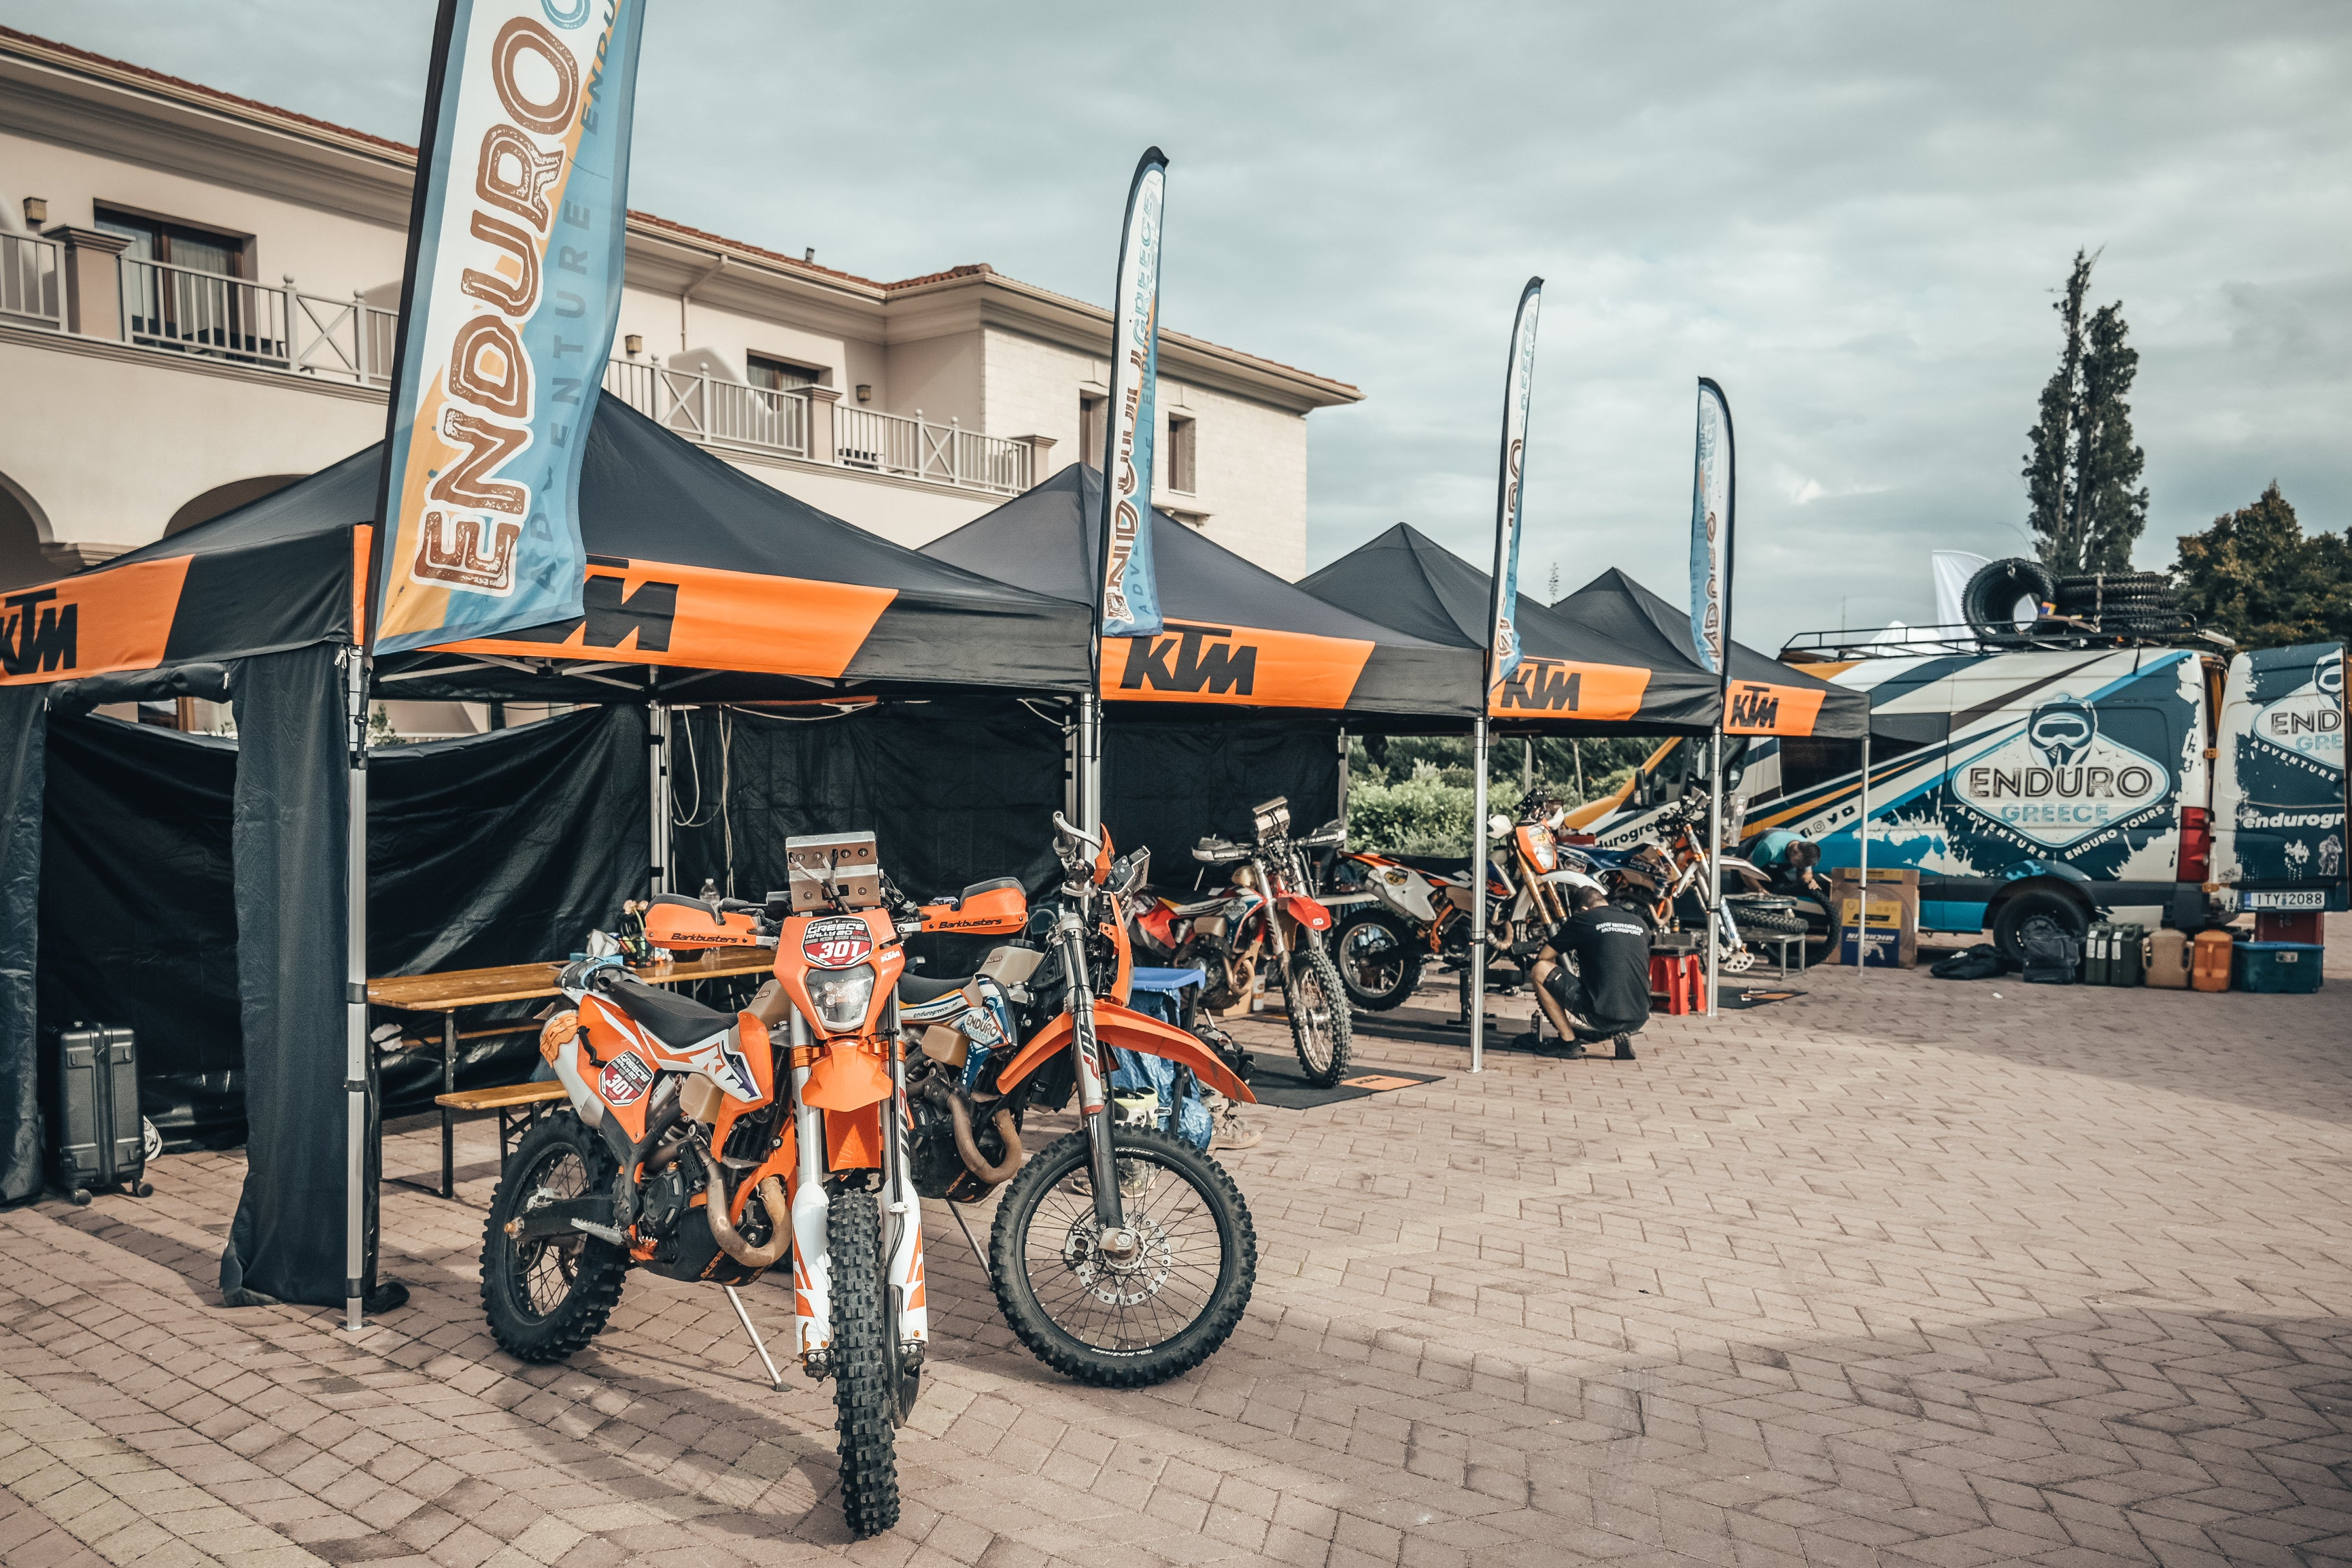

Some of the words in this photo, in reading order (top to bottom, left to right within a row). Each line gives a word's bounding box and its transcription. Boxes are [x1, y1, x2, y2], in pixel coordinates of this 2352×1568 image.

[414, 16, 579, 590] ENDURO
[1119, 623, 1257, 696] KTM
[1500, 659, 1581, 711] KTM
[1730, 685, 1779, 728] KTM
[2270, 711, 2342, 736] END
[2251, 740, 2336, 782] ADVENTURE
[1969, 766, 2152, 798] ENDURO
[2001, 804, 2110, 823] GREECE
[1957, 806, 2047, 859] ADVENTURE
[2064, 830, 2118, 860] ENDURO
[2120, 805, 2165, 831] TOURS
[2288, 891, 2323, 906] 2088
[806, 930, 836, 940] RALLY
[808, 923, 866, 934] GREECE
[938, 919, 1002, 930] Barkbusters
[670, 932, 738, 944] Barkbusters
[1847, 932, 1896, 942] MICHEIN
[819, 942, 862, 959] 301
[881, 950, 901, 963] KTM
[966, 1014, 998, 1038] ENDURO
[968, 1027, 989, 1043] GREECE
[619, 1053, 651, 1083] GREECE
[605, 1073, 632, 1100] 301
